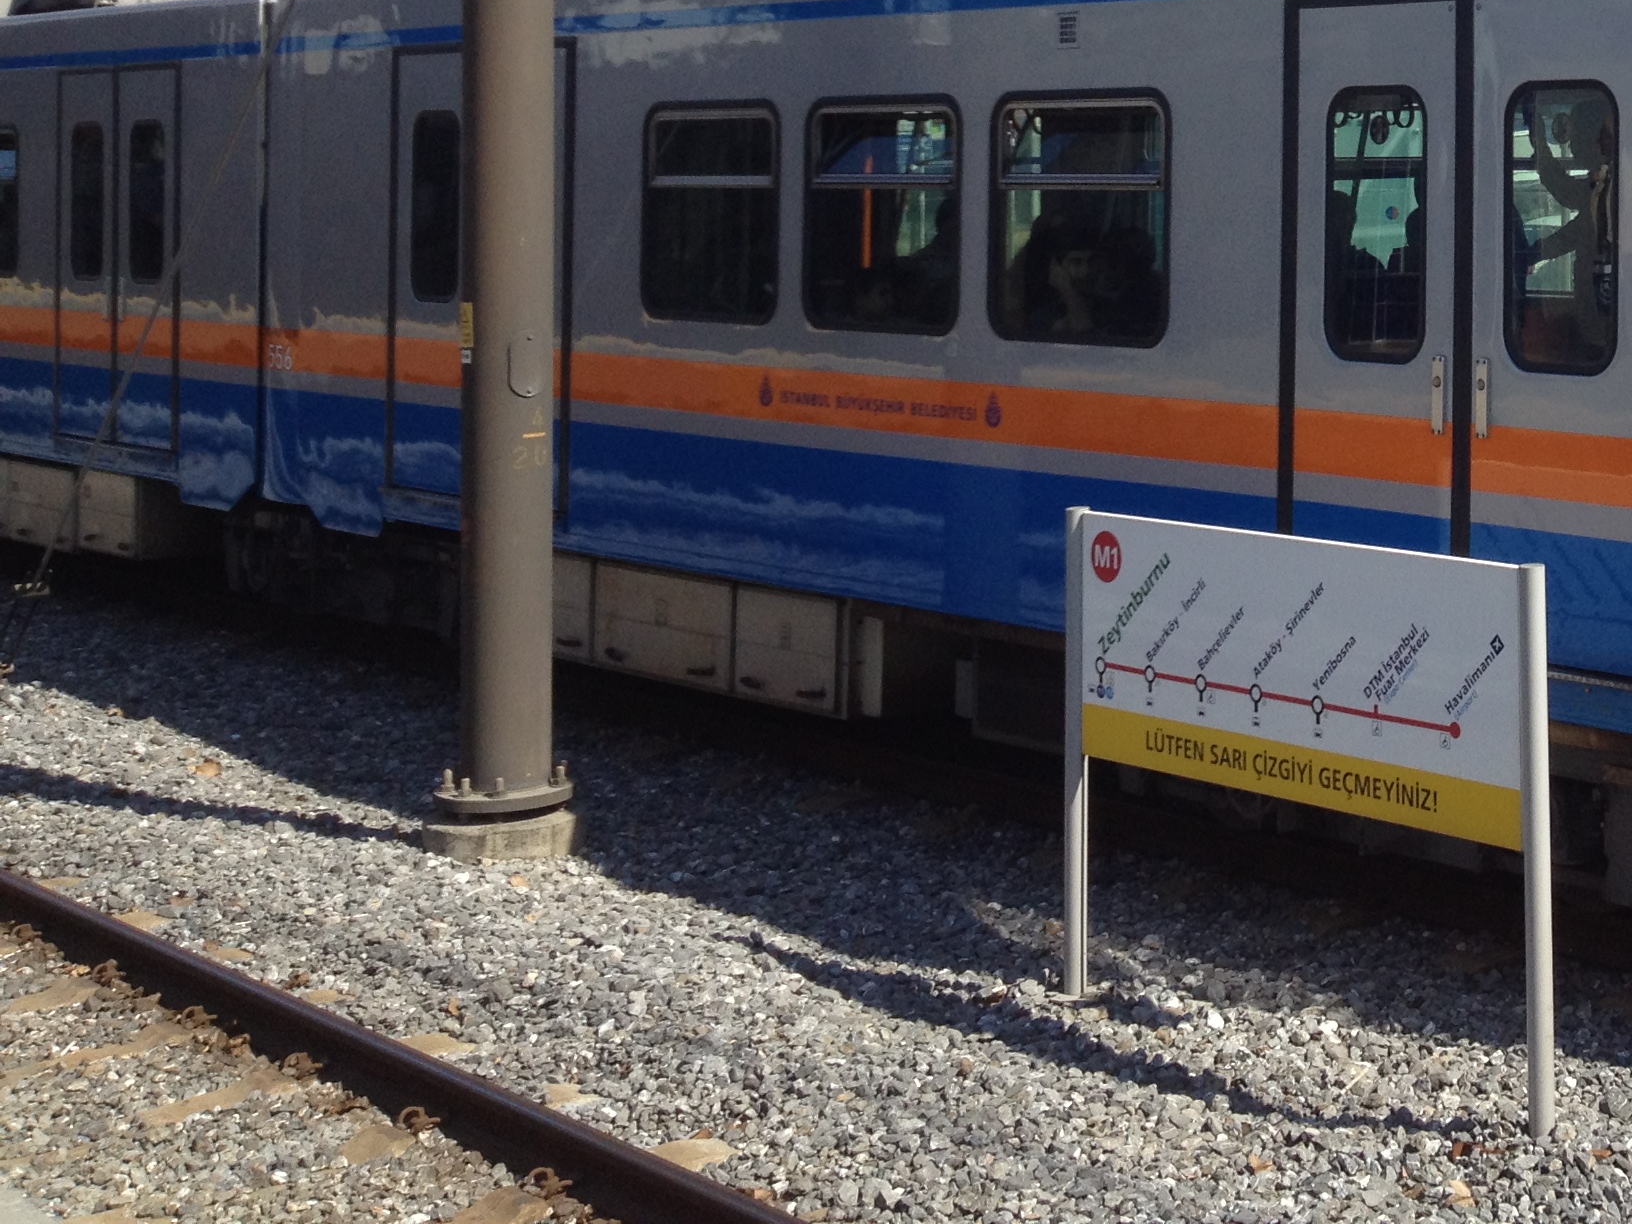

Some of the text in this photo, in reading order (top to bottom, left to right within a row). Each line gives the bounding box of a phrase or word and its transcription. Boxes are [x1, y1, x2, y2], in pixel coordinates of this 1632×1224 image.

[1094, 543, 1119, 570] M1
[1097, 553, 1171, 655] Zeytinburnu
[1145, 615, 1180, 663] Bakırköy
[1197, 606, 1246, 672] Bahçelievler
[1253, 637, 1283, 678] Ataköy
[1285, 581, 1326, 638] Şirinevler
[1312, 635, 1357, 691] Yenibosna
[1363, 622, 1419, 699] DTM İstanbul
[1375, 626, 1430, 702] Fuar Merkezi
[1444, 650, 1496, 715] Havalimanı
[1145, 728, 1438, 813] LÜTFEN SARI ÇİZGİYİ GEÇMEYİNİZ!
